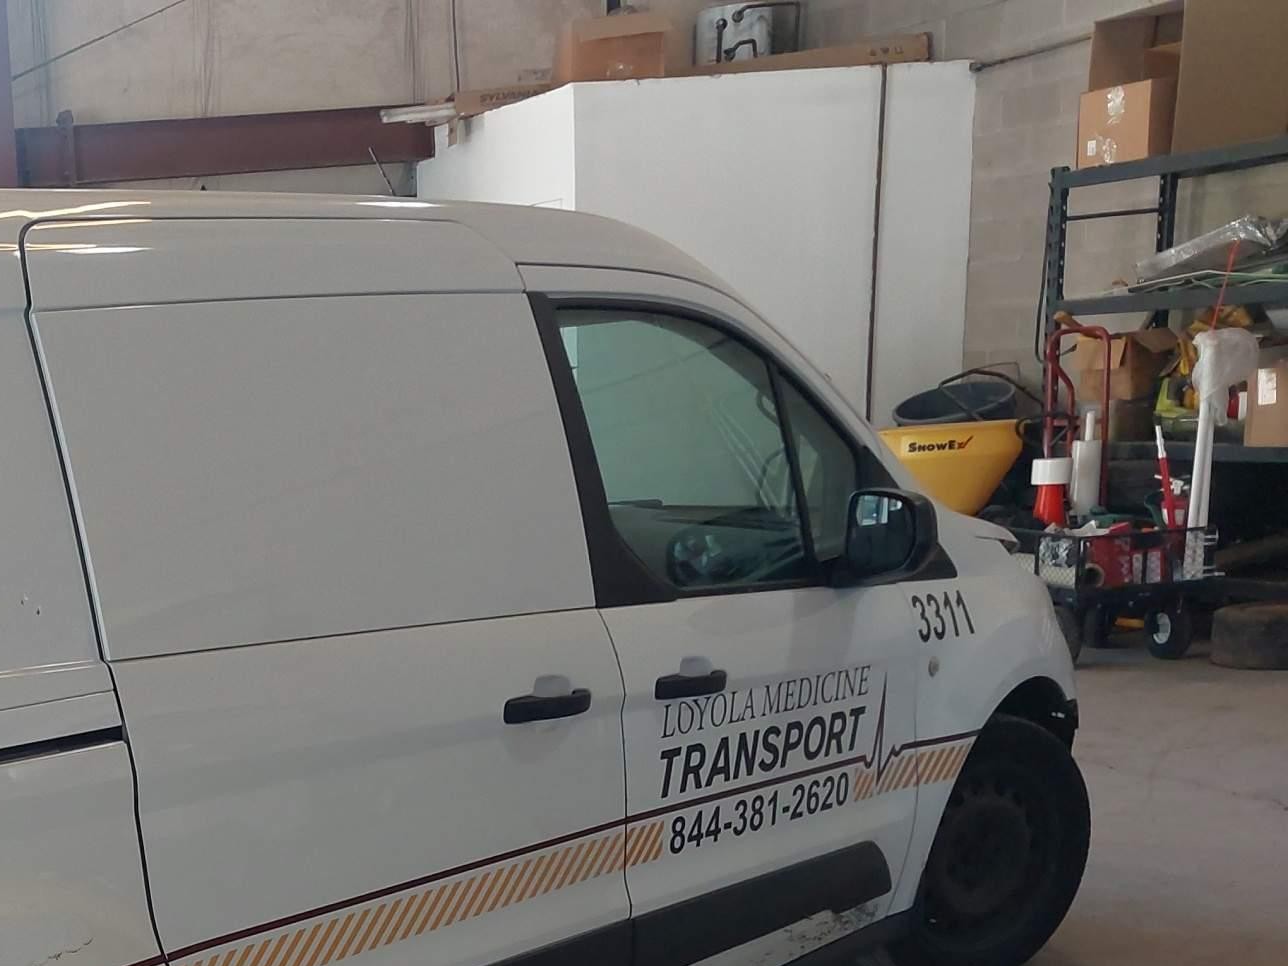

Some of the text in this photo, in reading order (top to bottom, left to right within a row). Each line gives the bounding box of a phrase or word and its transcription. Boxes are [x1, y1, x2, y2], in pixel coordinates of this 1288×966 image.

[911, 589, 975, 643] 3311
[660, 664, 871, 739] LOYOLA MEDICINE
[660, 705, 867, 799] TRANSPORT
[669, 771, 850, 855] 844-381-2620
